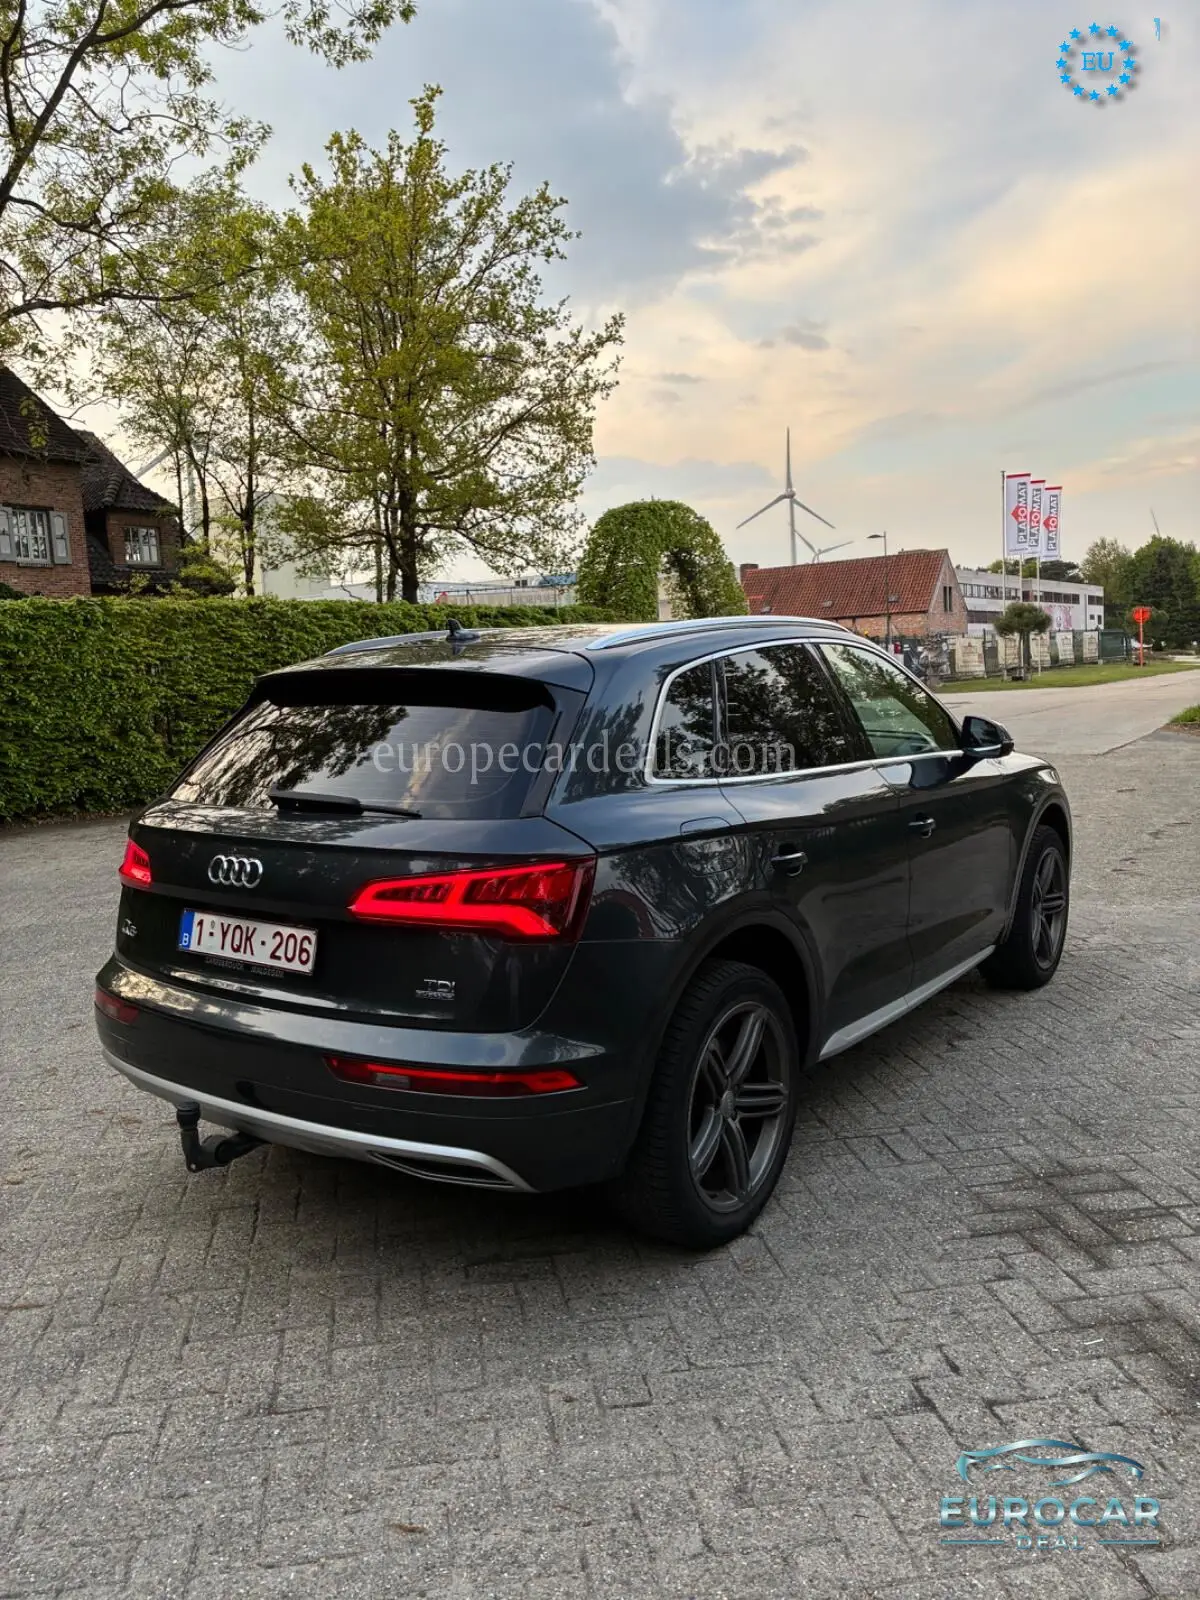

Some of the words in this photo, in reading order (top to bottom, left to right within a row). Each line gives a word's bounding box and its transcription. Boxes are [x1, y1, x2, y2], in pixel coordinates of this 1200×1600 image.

[1017, 483, 1027, 543] PLAFOMAT
[1029, 488, 1041, 546] PLAFOMAT
[1047, 495, 1058, 550] PLAFOMAT
[182, 933, 190, 946] B
[423, 978, 456, 992] TDI
